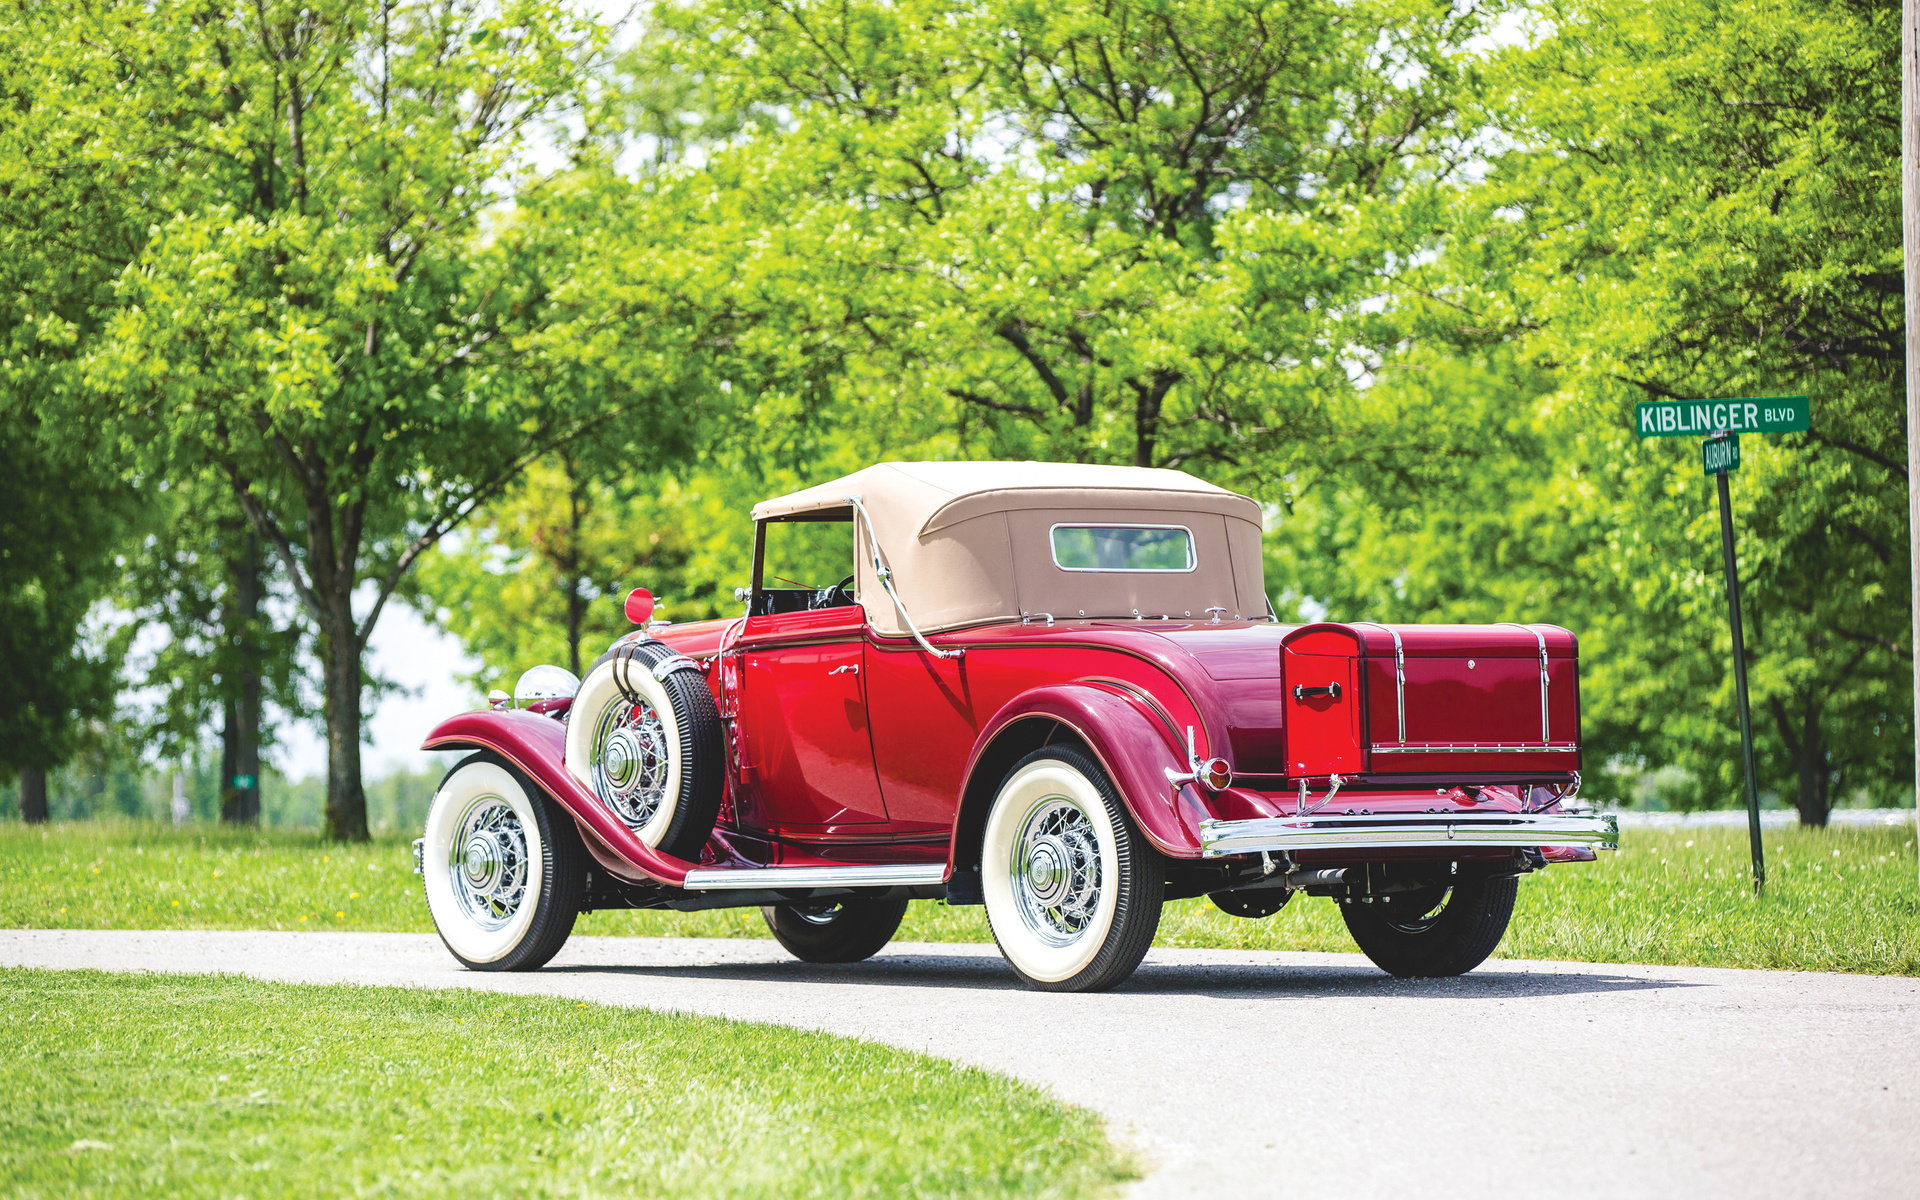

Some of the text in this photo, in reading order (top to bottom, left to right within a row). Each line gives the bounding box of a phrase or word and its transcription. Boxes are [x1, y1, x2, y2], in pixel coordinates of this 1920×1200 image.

[1641, 403, 1795, 432] KIBLINGER BLVD
[1705, 440, 1732, 470] AUBURN
